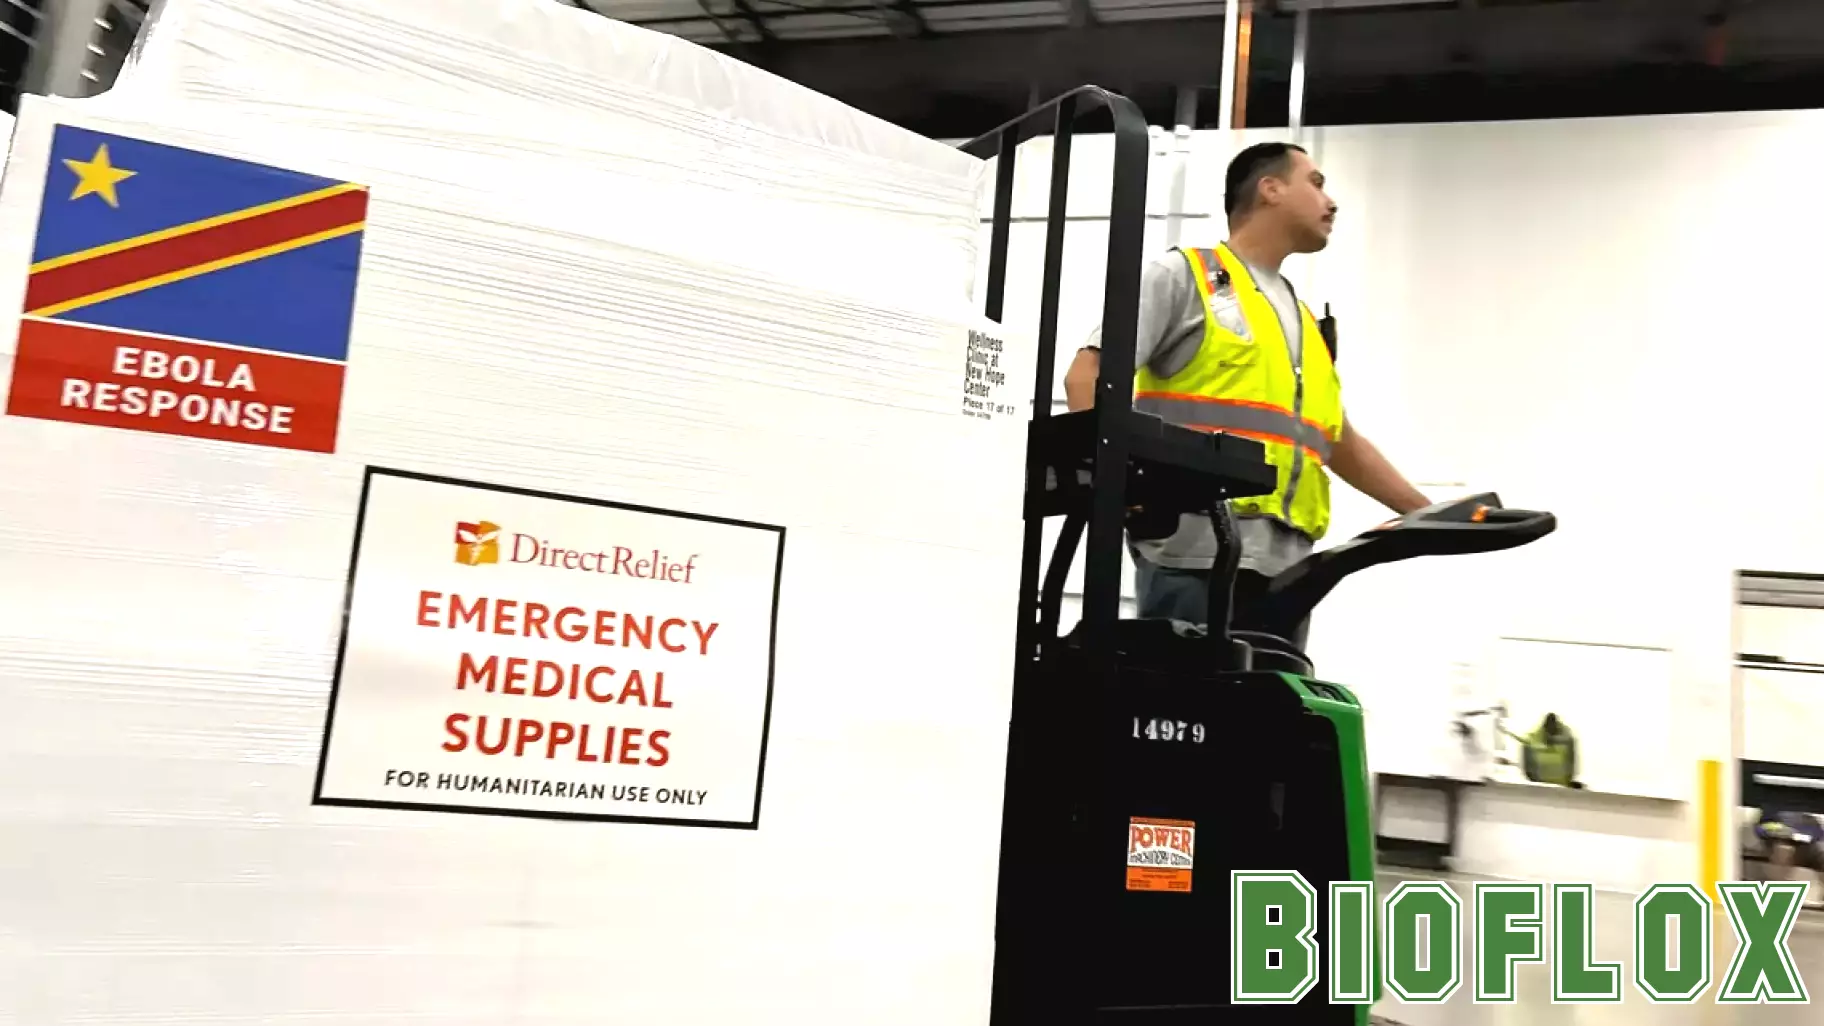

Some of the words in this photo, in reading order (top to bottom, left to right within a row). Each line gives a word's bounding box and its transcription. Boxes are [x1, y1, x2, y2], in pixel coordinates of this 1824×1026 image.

[966, 346, 989, 365] Clinic
[991, 353, 998, 367] at
[968, 329, 1003, 352] Wellness
[112, 345, 257, 392] EBOLA
[965, 361, 984, 380] New
[985, 366, 1004, 387] Hope
[60, 376, 297, 434] RESPONSE
[964, 380, 990, 398] Center
[416, 589, 720, 656] EMERGENCY
[455, 651, 674, 709] MEDICAL
[440, 712, 673, 768] SUPPLIES
[1132, 716, 1206, 743] 14979
[383, 769, 431, 789] FOR
[435, 772, 606, 800] HUMANITARIAN
[611, 785, 650, 803] USE
[655, 787, 708, 807] ONLY
[1130, 825, 1192, 857] POWER
